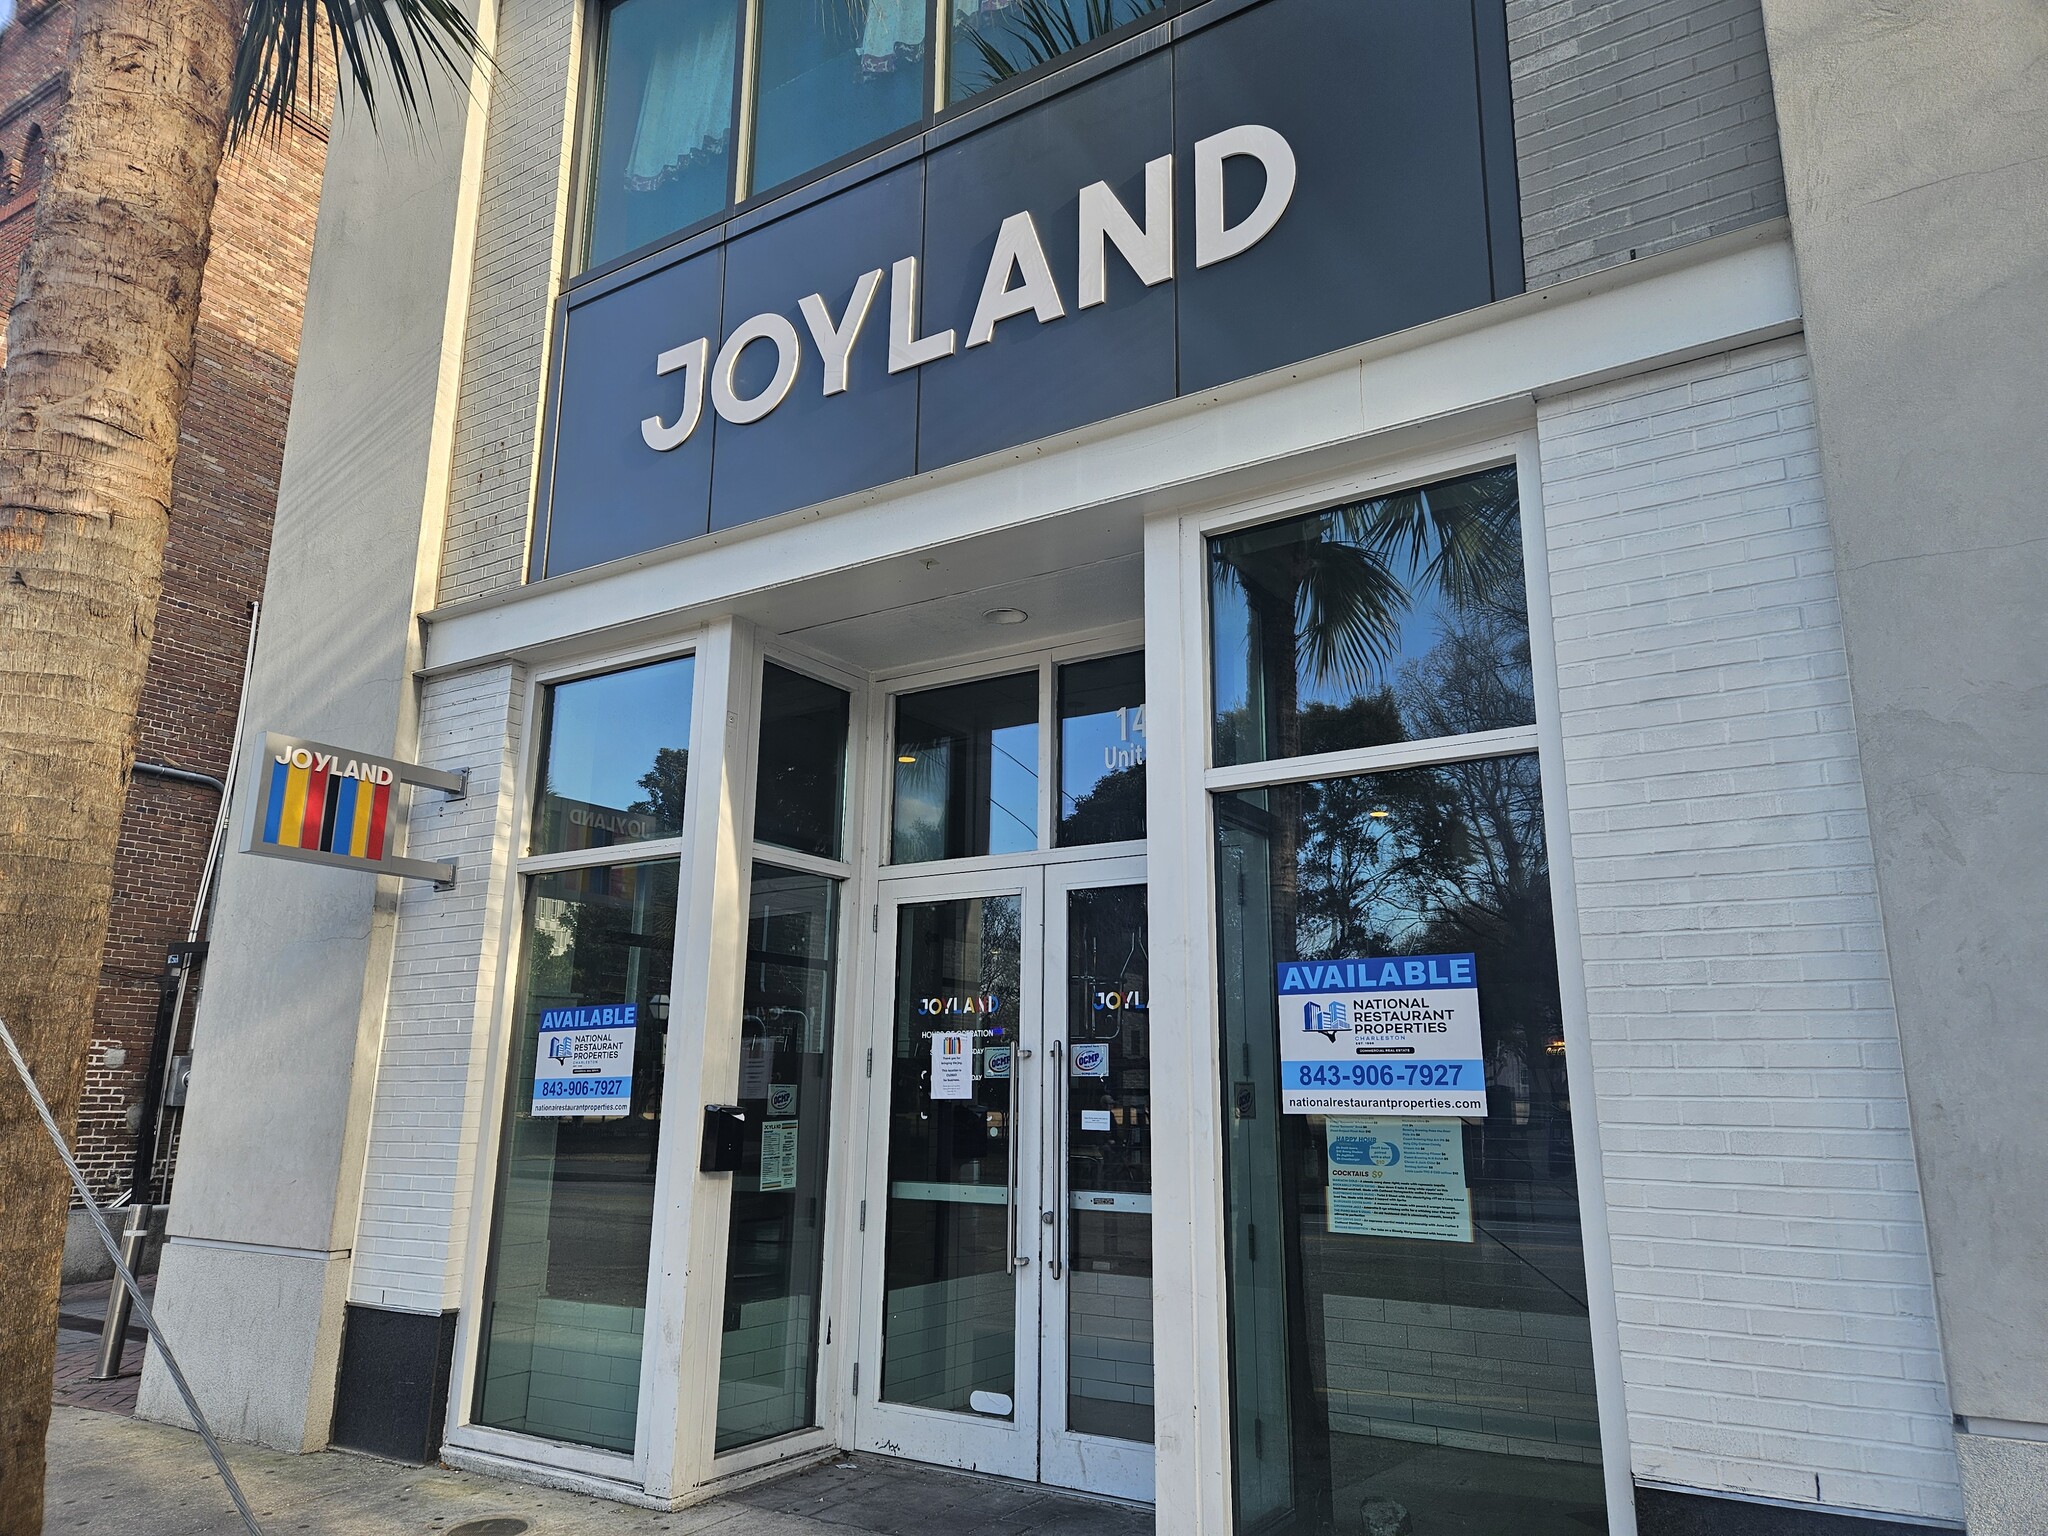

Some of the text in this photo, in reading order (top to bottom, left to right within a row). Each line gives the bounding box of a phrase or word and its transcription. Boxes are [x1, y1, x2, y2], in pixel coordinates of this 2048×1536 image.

[641, 124, 1297, 452] JOYLAND
[1104, 743, 1143, 769] Unit
[275, 746, 394, 786] JOYLAND
[1282, 958, 1472, 990] AVAILABLE
[918, 995, 999, 1015] JOYLAND
[1353, 997, 1430, 1010] NATIONAL
[541, 1006, 635, 1029] AVAILABLE
[1354, 1009, 1455, 1022] RESTAURANT
[1355, 1022, 1447, 1035] PROPERTIES
[574, 1034, 612, 1043] NATIONAL
[574, 1042, 624, 1052] RESTAURANT
[573, 1051, 619, 1060] PROPERTIES
[1078, 1053, 1100, 1066] OCMP
[1299, 1064, 1463, 1086] 843-906-7927
[542, 1080, 623, 1096] 843-906-7927
[535, 1103, 628, 1112] nationalrestaurantproperties.com
[1289, 1097, 1481, 1111] nationalrestaurantproperties.com
[1332, 1169, 1383, 1178] COCKTAILS $9
